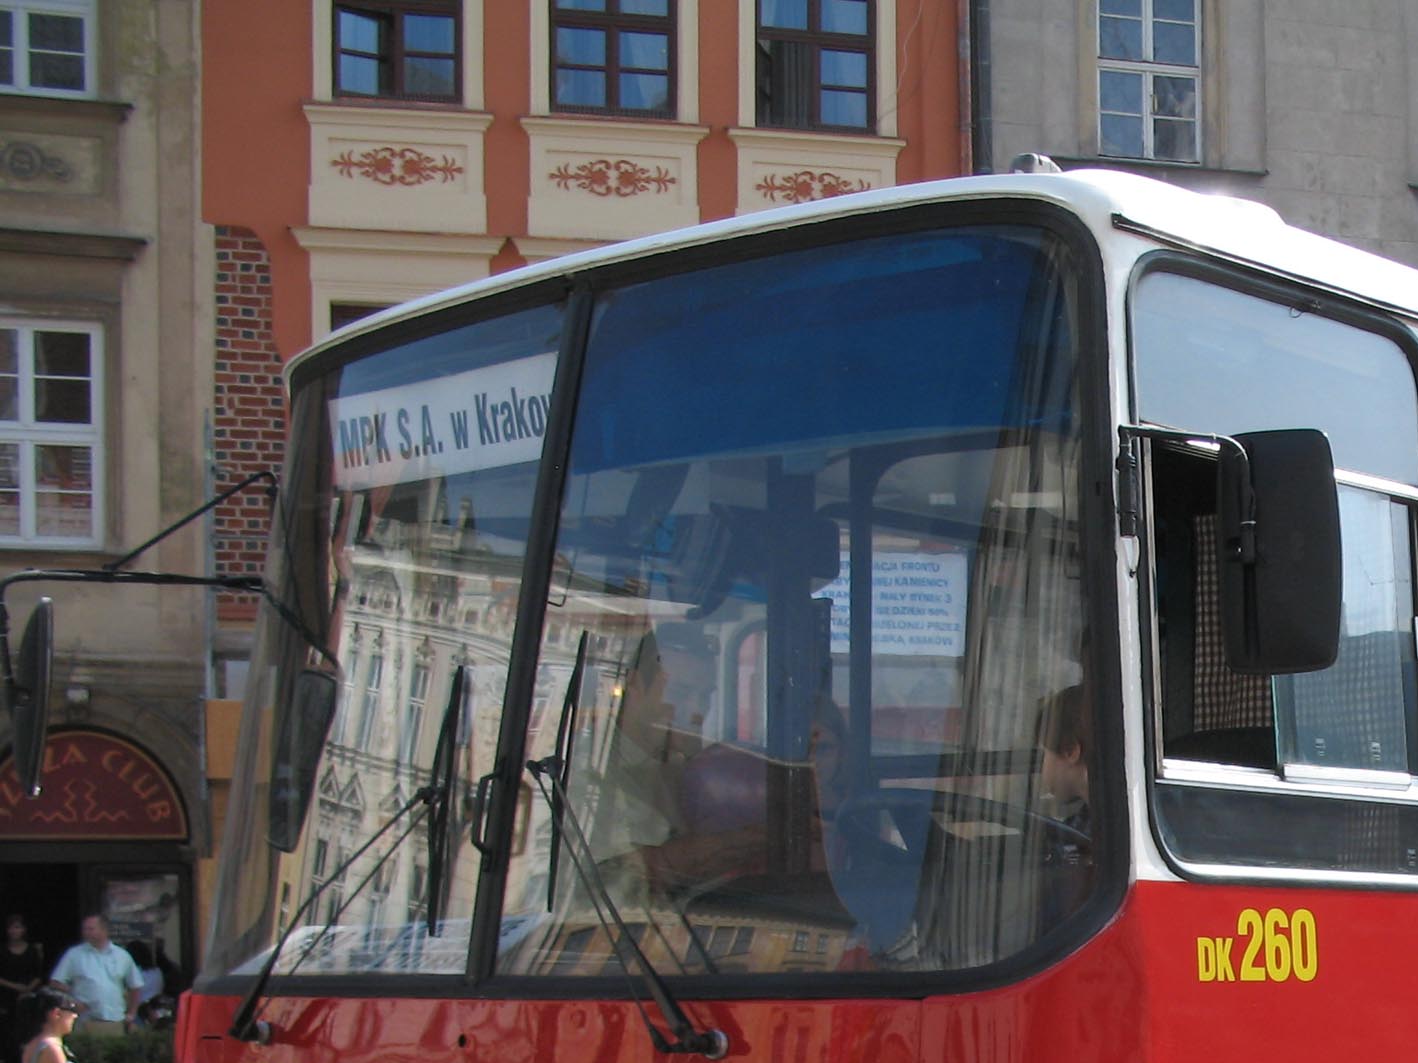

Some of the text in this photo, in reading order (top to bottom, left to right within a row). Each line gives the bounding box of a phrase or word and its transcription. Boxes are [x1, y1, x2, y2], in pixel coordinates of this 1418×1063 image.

[338, 412, 391, 468] MPK
[397, 405, 443, 460] S.A.
[450, 409, 469, 450] w
[102, 750, 171, 822] CLUB
[1197, 907, 1318, 982] DK 260
